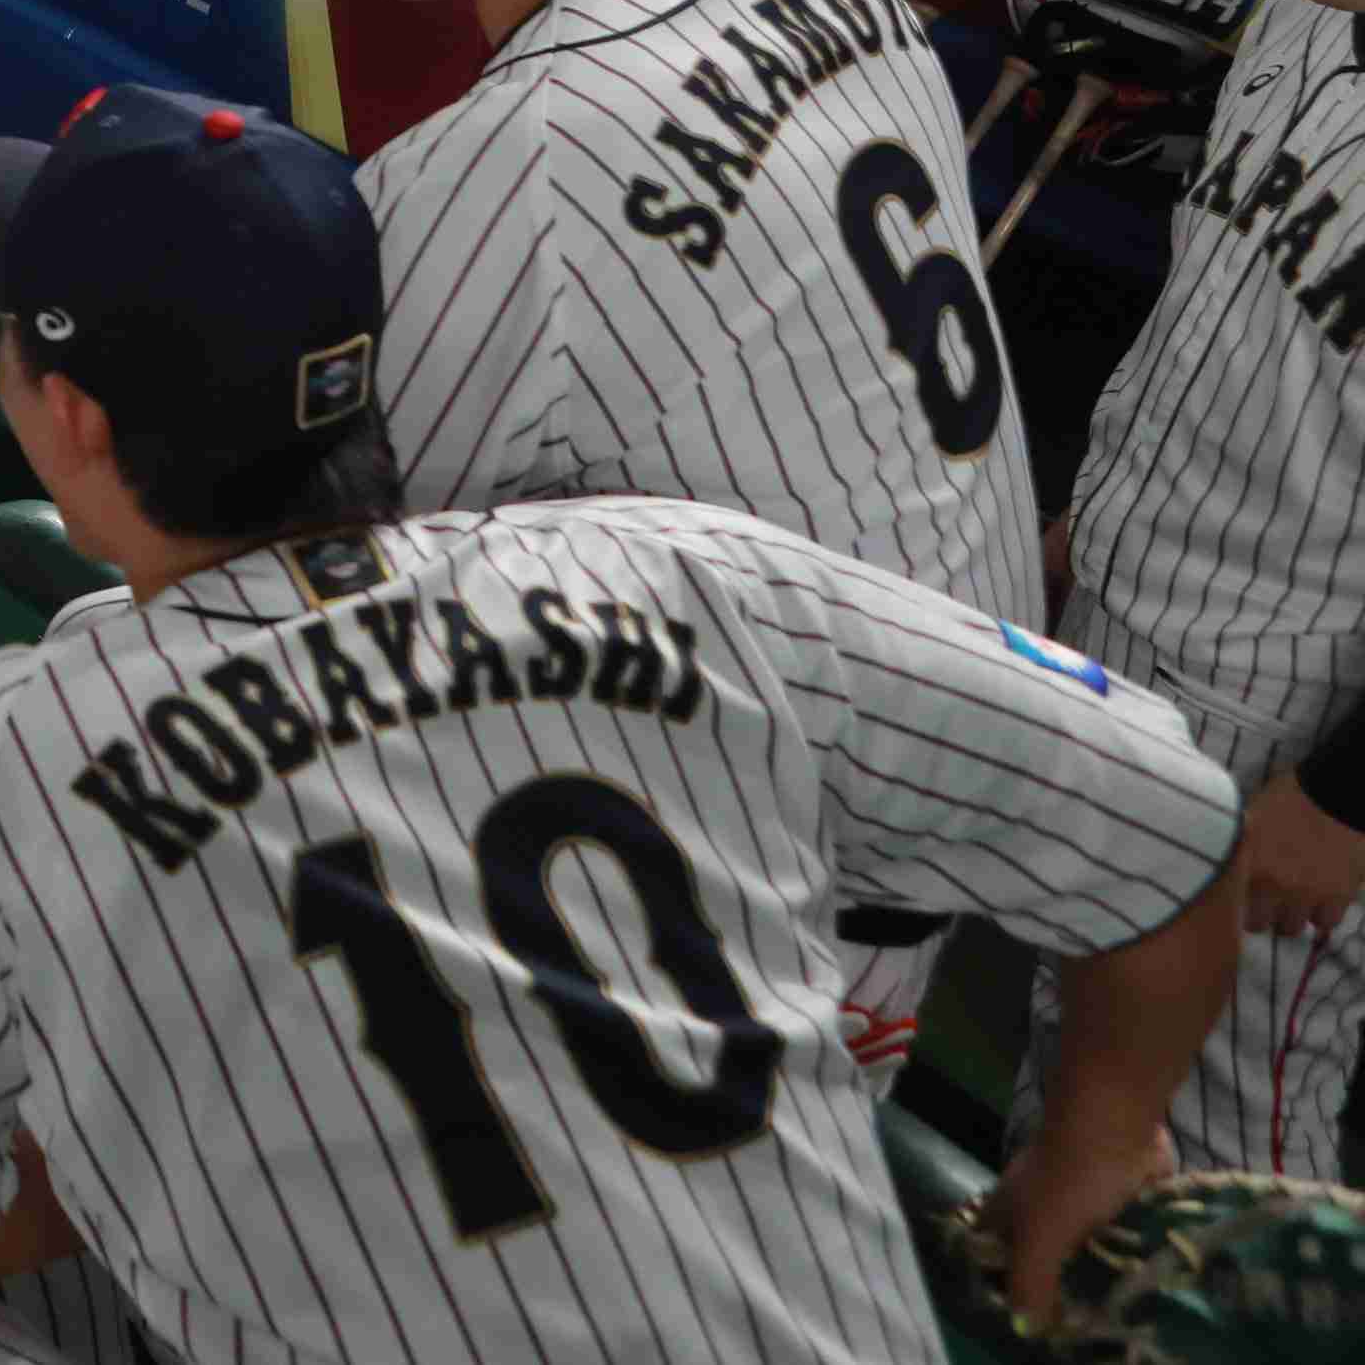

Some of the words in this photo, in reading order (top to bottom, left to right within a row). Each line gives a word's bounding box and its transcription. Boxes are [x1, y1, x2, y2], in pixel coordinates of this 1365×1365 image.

[836, 136, 1005, 464] 6
[70, 584, 706, 876] KOBAYASHI
[289, 770, 787, 1247] 10
